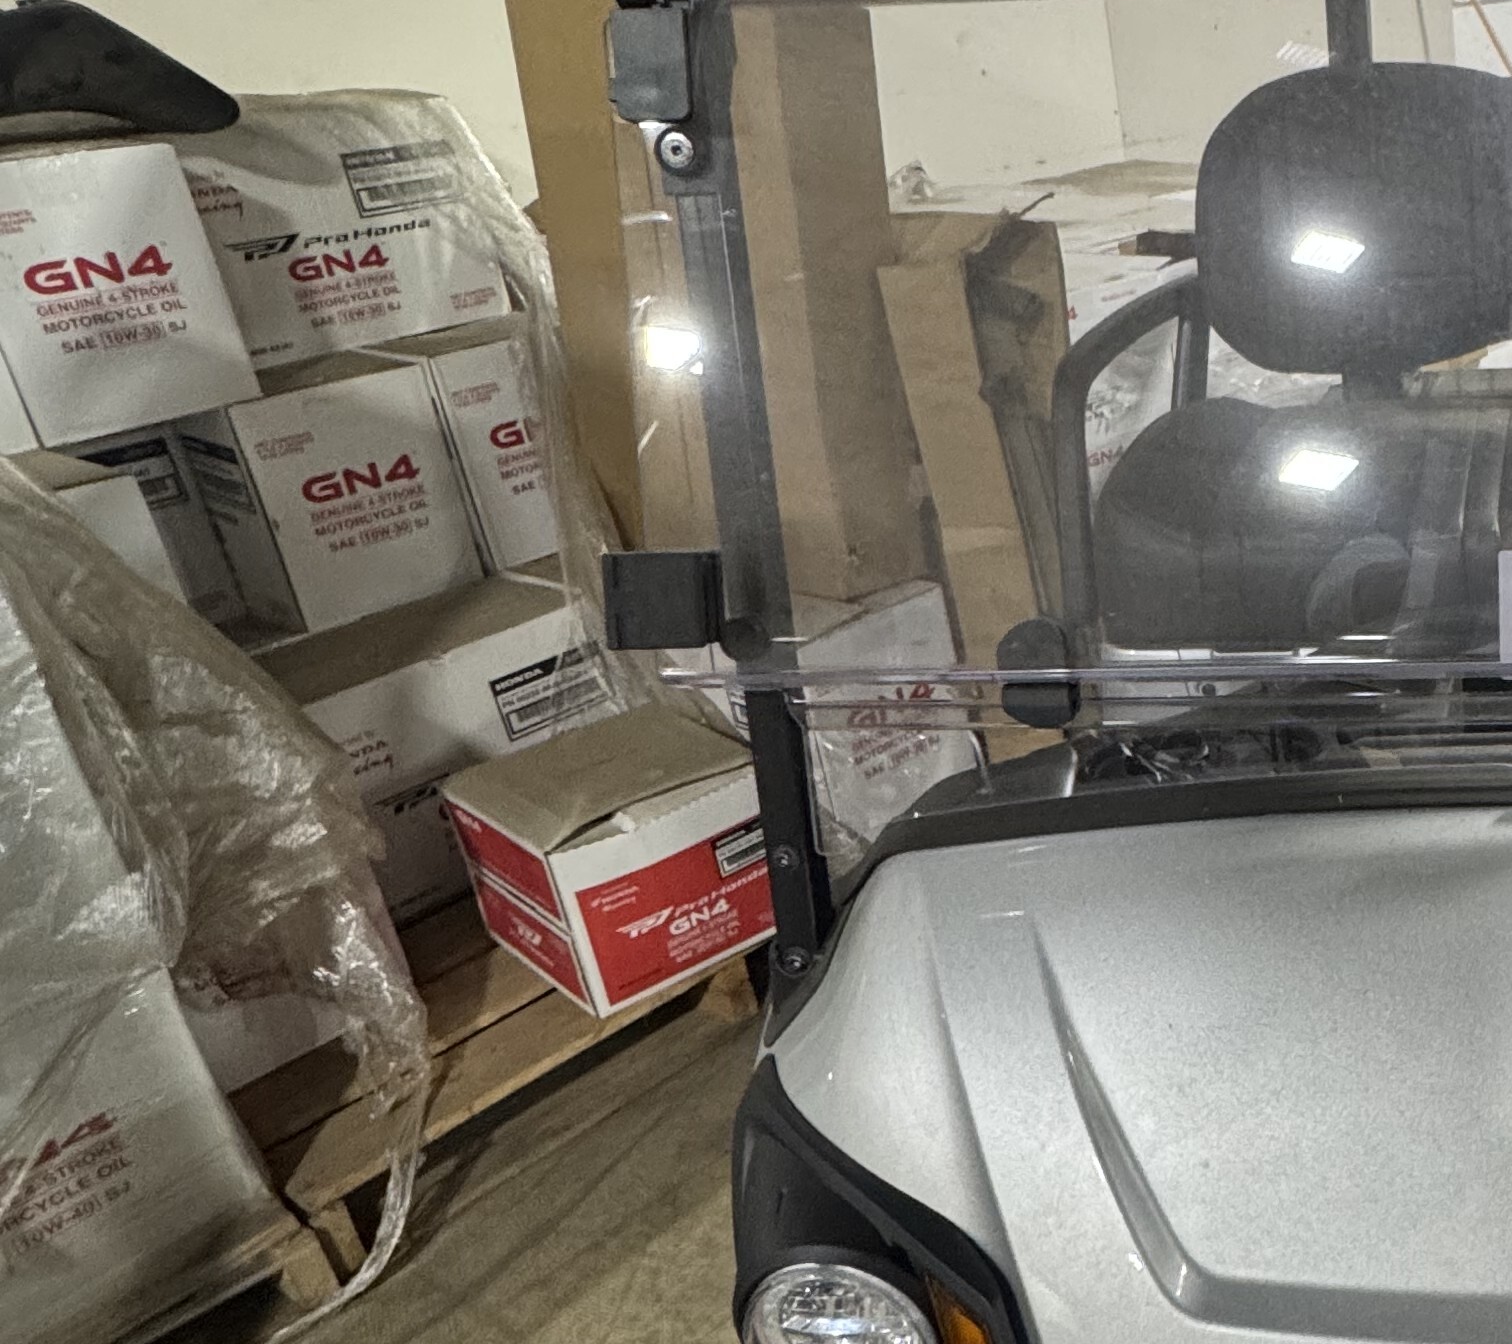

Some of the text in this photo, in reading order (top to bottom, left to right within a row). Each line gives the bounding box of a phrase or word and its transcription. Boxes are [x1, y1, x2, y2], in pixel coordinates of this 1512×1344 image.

[23, 244, 173, 295] GN4
[288, 244, 390, 281] GN4
[36, 295, 103, 319] GENUINE
[42, 298, 188, 335] MOTORCYCLE OIL
[299, 289, 381, 313] MOTORCYCLE
[61, 337, 99, 355] SAE
[302, 454, 420, 504] GN4
[315, 508, 406, 537] MOTORCYCLE
[669, 898, 730, 936] GN4
